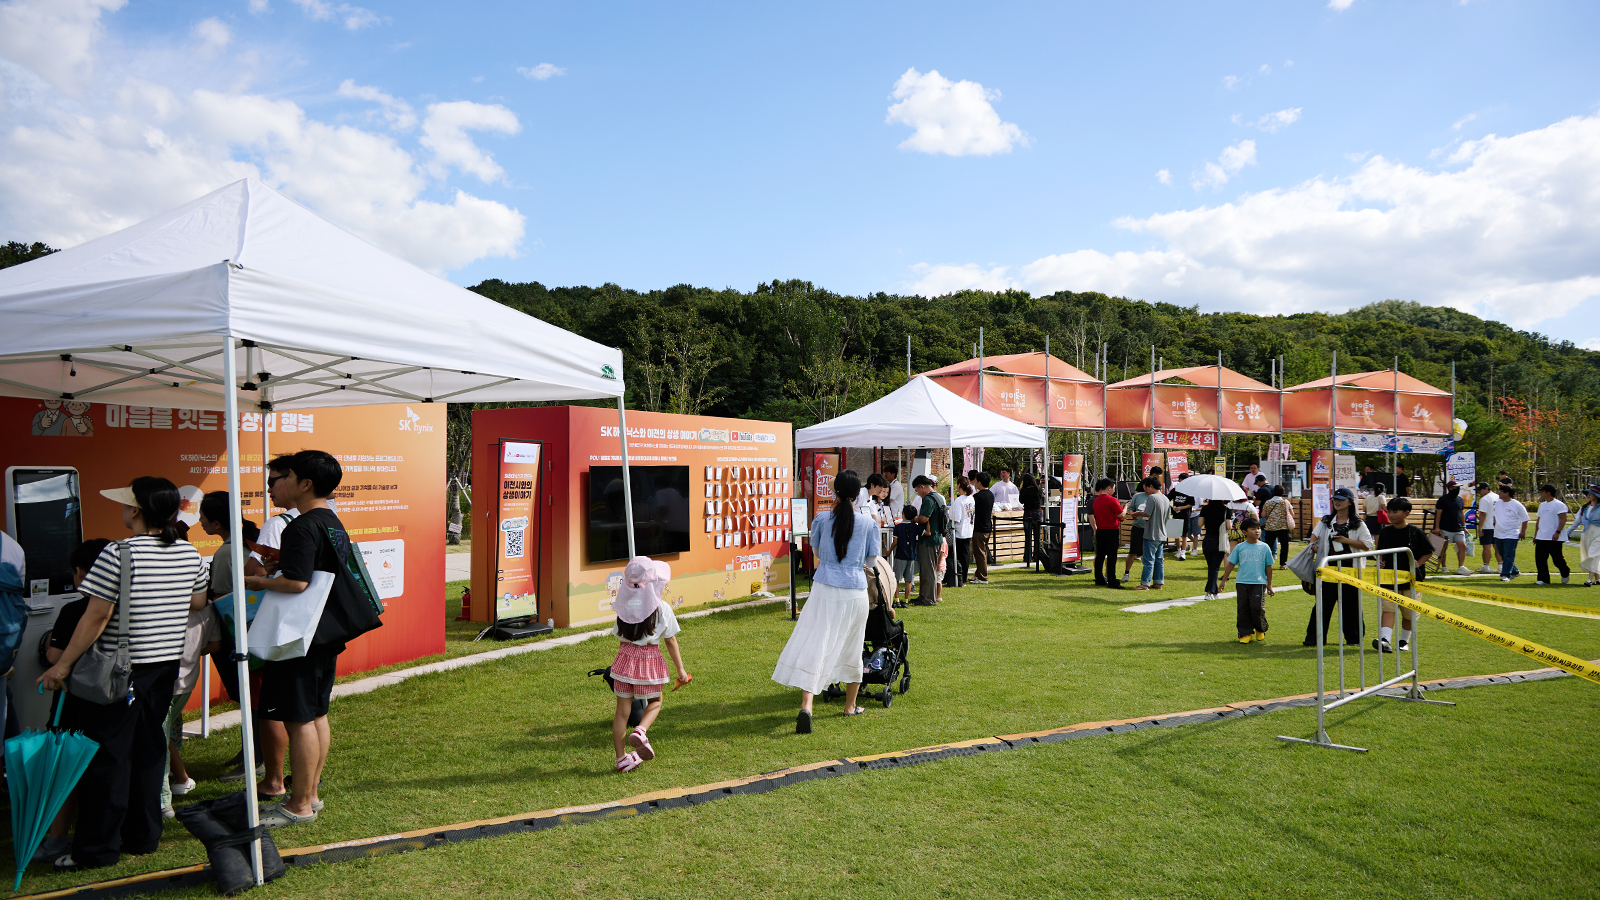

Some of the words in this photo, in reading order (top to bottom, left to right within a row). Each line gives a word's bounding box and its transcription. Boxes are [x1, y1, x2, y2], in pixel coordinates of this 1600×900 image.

[106, 404, 173, 429] 마음을
[178, 409, 217, 431] 잇는
[281, 413, 314, 433] 행복
[399, 419, 411, 431] SK
[413, 422, 434, 434] hynix
[600, 426, 646, 438] SK하닉스와
[647, 428, 666, 439] 이천의
[667, 430, 679, 439] 상생
[680, 430, 697, 440] 이야기
[1154, 431, 1215, 447] 흥만쌀상회
[503, 481, 533, 489] 이천시와의
[502, 491, 532, 500] 상생이야기
